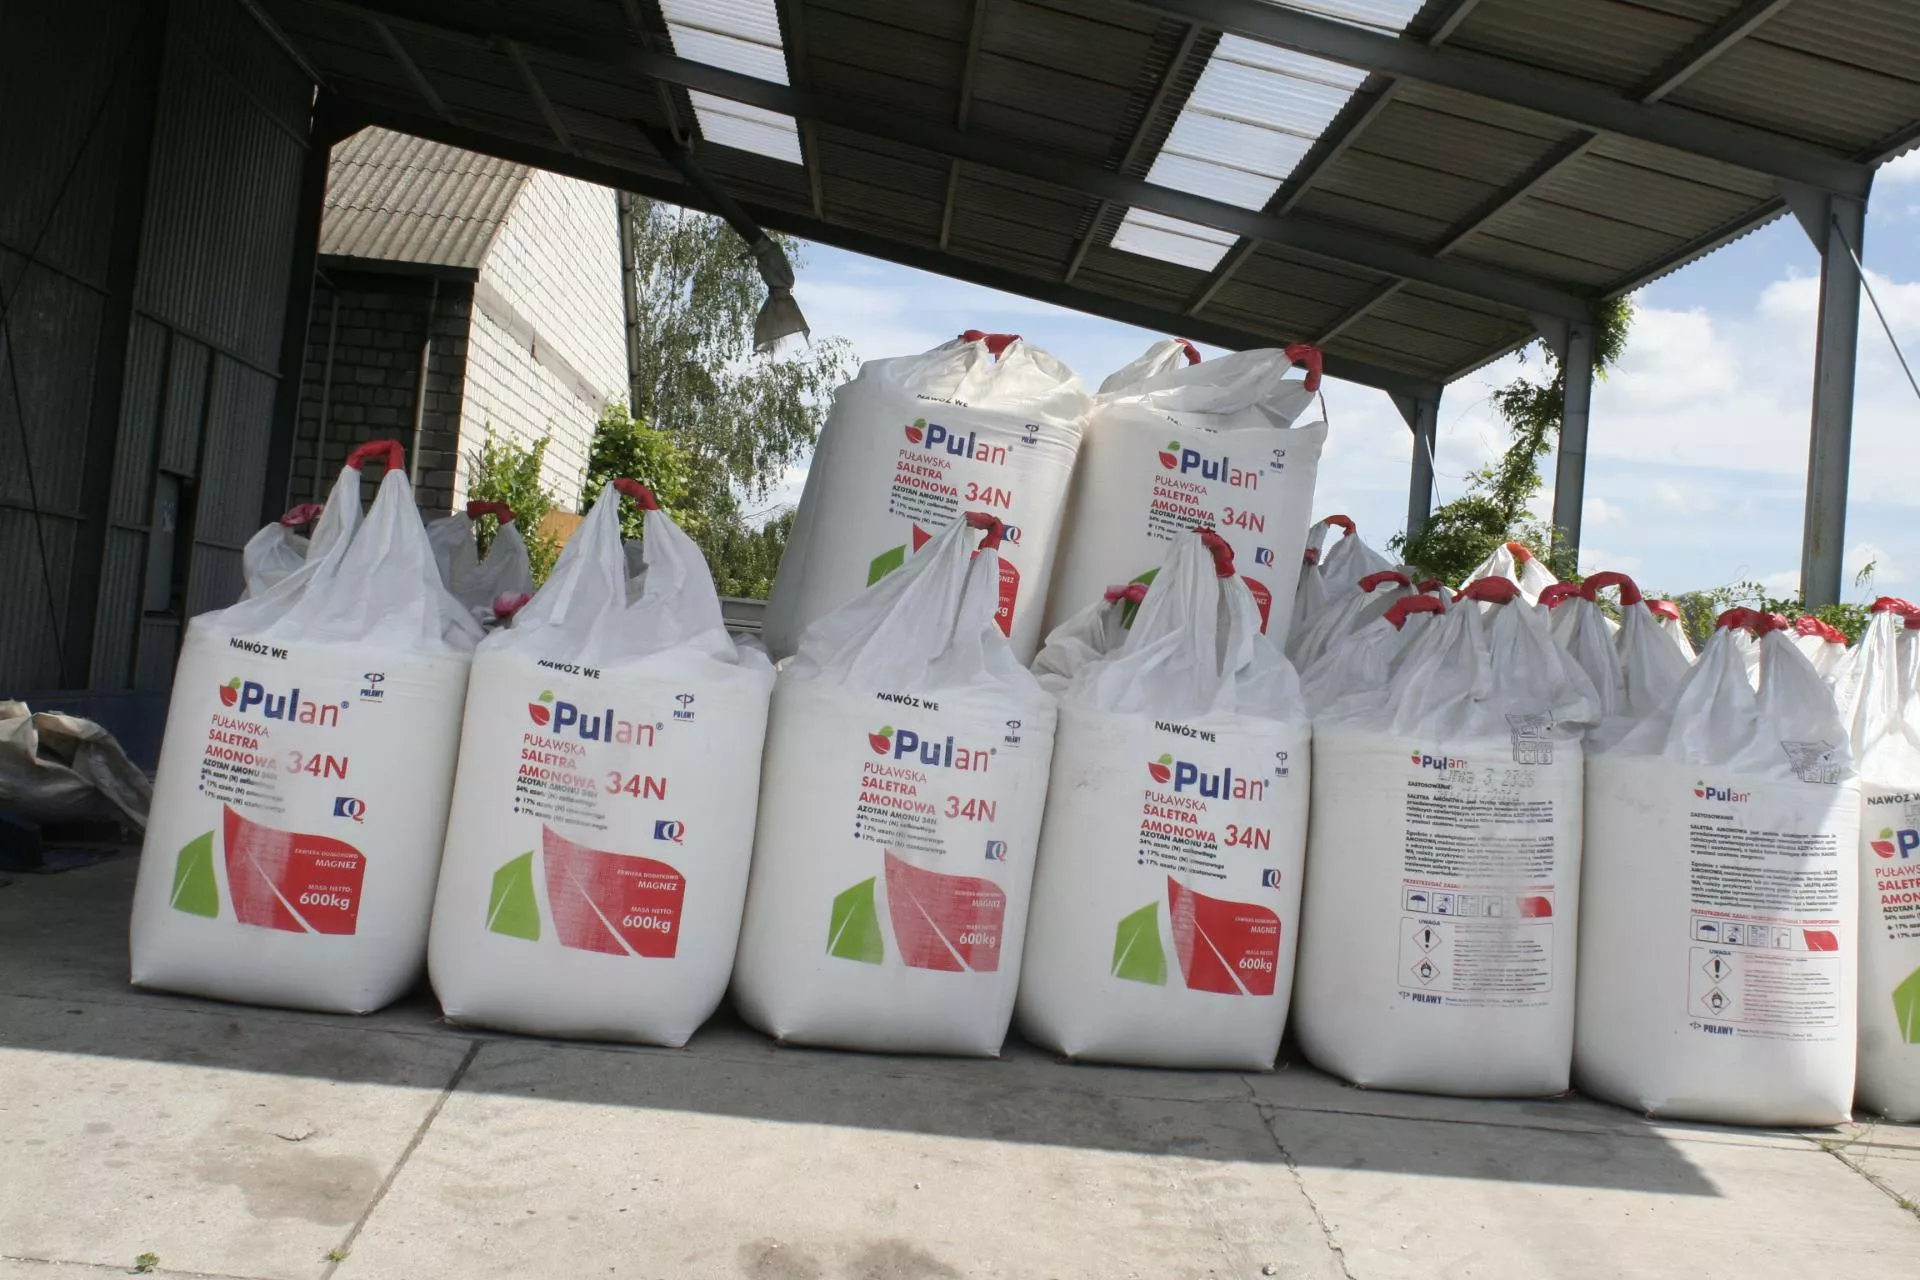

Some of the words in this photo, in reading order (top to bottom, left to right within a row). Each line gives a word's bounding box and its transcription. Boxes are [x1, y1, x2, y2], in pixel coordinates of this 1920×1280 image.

[899, 449, 951, 469] PUŁAWSKA
[896, 461, 943, 481] SALETRA
[894, 474, 958, 497] AMONOWA
[965, 482, 1012, 510] 34N
[1153, 487, 1199, 505] SALETRA
[1155, 475, 1207, 496] PUŁAWSKA
[1151, 499, 1215, 522] AMONOWA
[1222, 507, 1265, 533] 34N
[230, 637, 268, 655] NAWÓZ
[272, 647, 288, 659] WE
[583, 667, 600, 680] WE
[877, 692, 919, 708] NAWÓZ
[923, 700, 939, 711] WE
[211, 714, 270, 738] PUŁAWSKA
[1155, 721, 1197, 738] NAWÓZ
[1200, 731, 1216, 742] WE
[208, 729, 258, 751] SALETRA
[523, 733, 586, 758] PUŁAWSKA
[203, 758, 230, 770] AZOTAN
[231, 764, 260, 777] AMONU
[205, 745, 277, 769] AMONOWA
[285, 750, 348, 779] 34N
[521, 748, 577, 770] SALETRA
[518, 764, 596, 791] AMONOWA
[605, 770, 667, 801] 34N
[863, 761, 927, 784] PUŁAWSKA
[861, 776, 917, 797] SALETRA
[859, 792, 936, 816] AMONOWA
[944, 795, 997, 823] 34N
[1145, 790, 1208, 812] PUŁAWSKA
[857, 805, 889, 816] AZOTAN
[890, 811, 920, 822] AMONU
[1143, 804, 1198, 825] SALETRA
[1140, 830, 1171, 841] AZOTAN
[1172, 836, 1202, 847] AMONU
[1141, 819, 1217, 844] AMONOWA
[1224, 824, 1271, 851] 34N
[315, 859, 357, 870] MAGNEZ
[638, 880, 677, 891] MAGNEZ
[299, 892, 350, 911] 600kg
[1883, 904, 1913, 913] AZOTAN
[622, 914, 671, 933] 600kg
[959, 932, 996, 948] 600kg
[1239, 957, 1272, 973] 600kg
